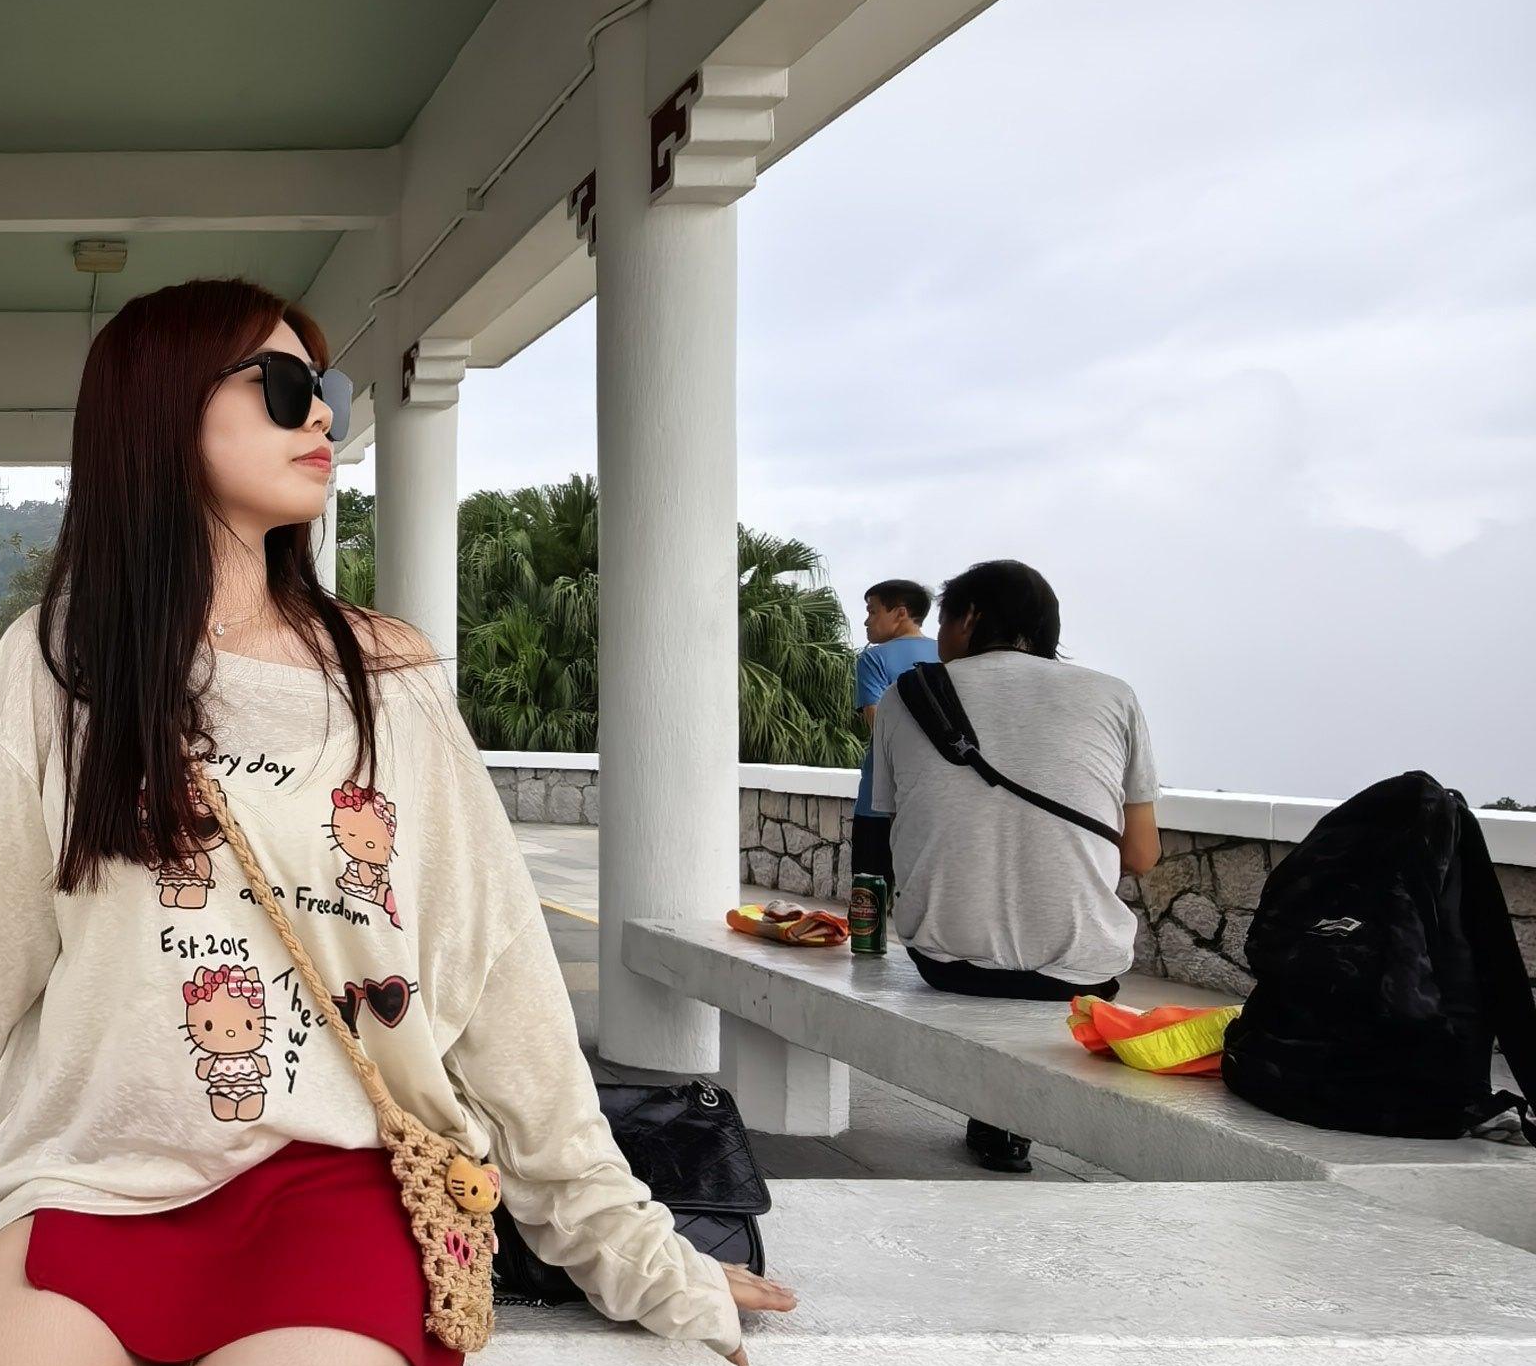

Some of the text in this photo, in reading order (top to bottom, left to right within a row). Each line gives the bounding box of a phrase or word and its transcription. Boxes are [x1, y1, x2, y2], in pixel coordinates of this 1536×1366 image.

[245, 753, 296, 787] day
[295, 886, 370, 926] Freedom
[272, 966, 312, 1028] The
